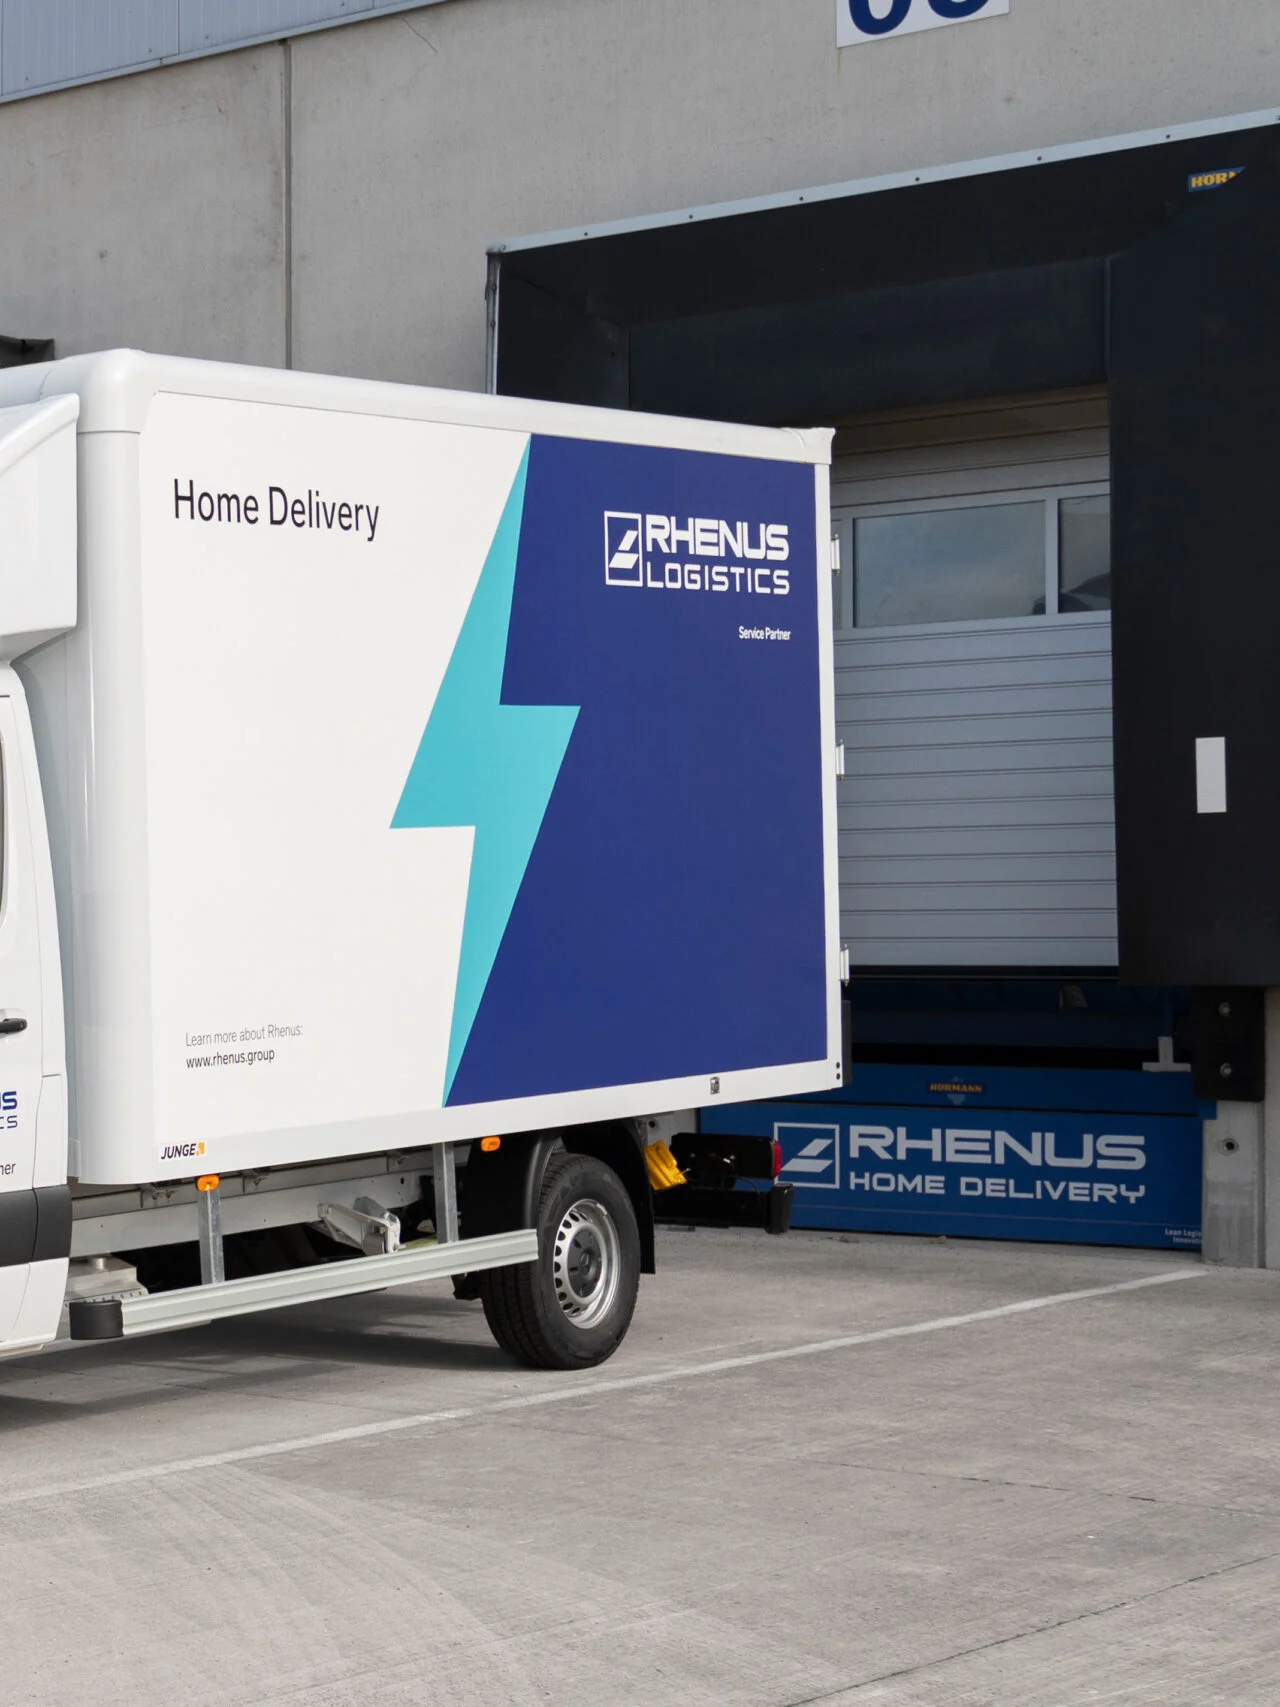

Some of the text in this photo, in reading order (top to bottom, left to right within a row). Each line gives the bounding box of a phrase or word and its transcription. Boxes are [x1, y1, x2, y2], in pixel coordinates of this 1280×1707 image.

[174, 478, 379, 542] Home Delivery
[645, 514, 790, 561] RHENUS
[646, 561, 790, 595] LOGISTICS
[738, 625, 791, 640] Service Partner
[185, 1024, 303, 1047] Learn more about Rhenus:
[186, 1049, 275, 1068] www.rhenus.group
[160, 1143, 197, 1160] JUNGE
[850, 1125, 1146, 1170] RHENUS
[850, 1172, 1146, 1203] HOME DELIVERY
